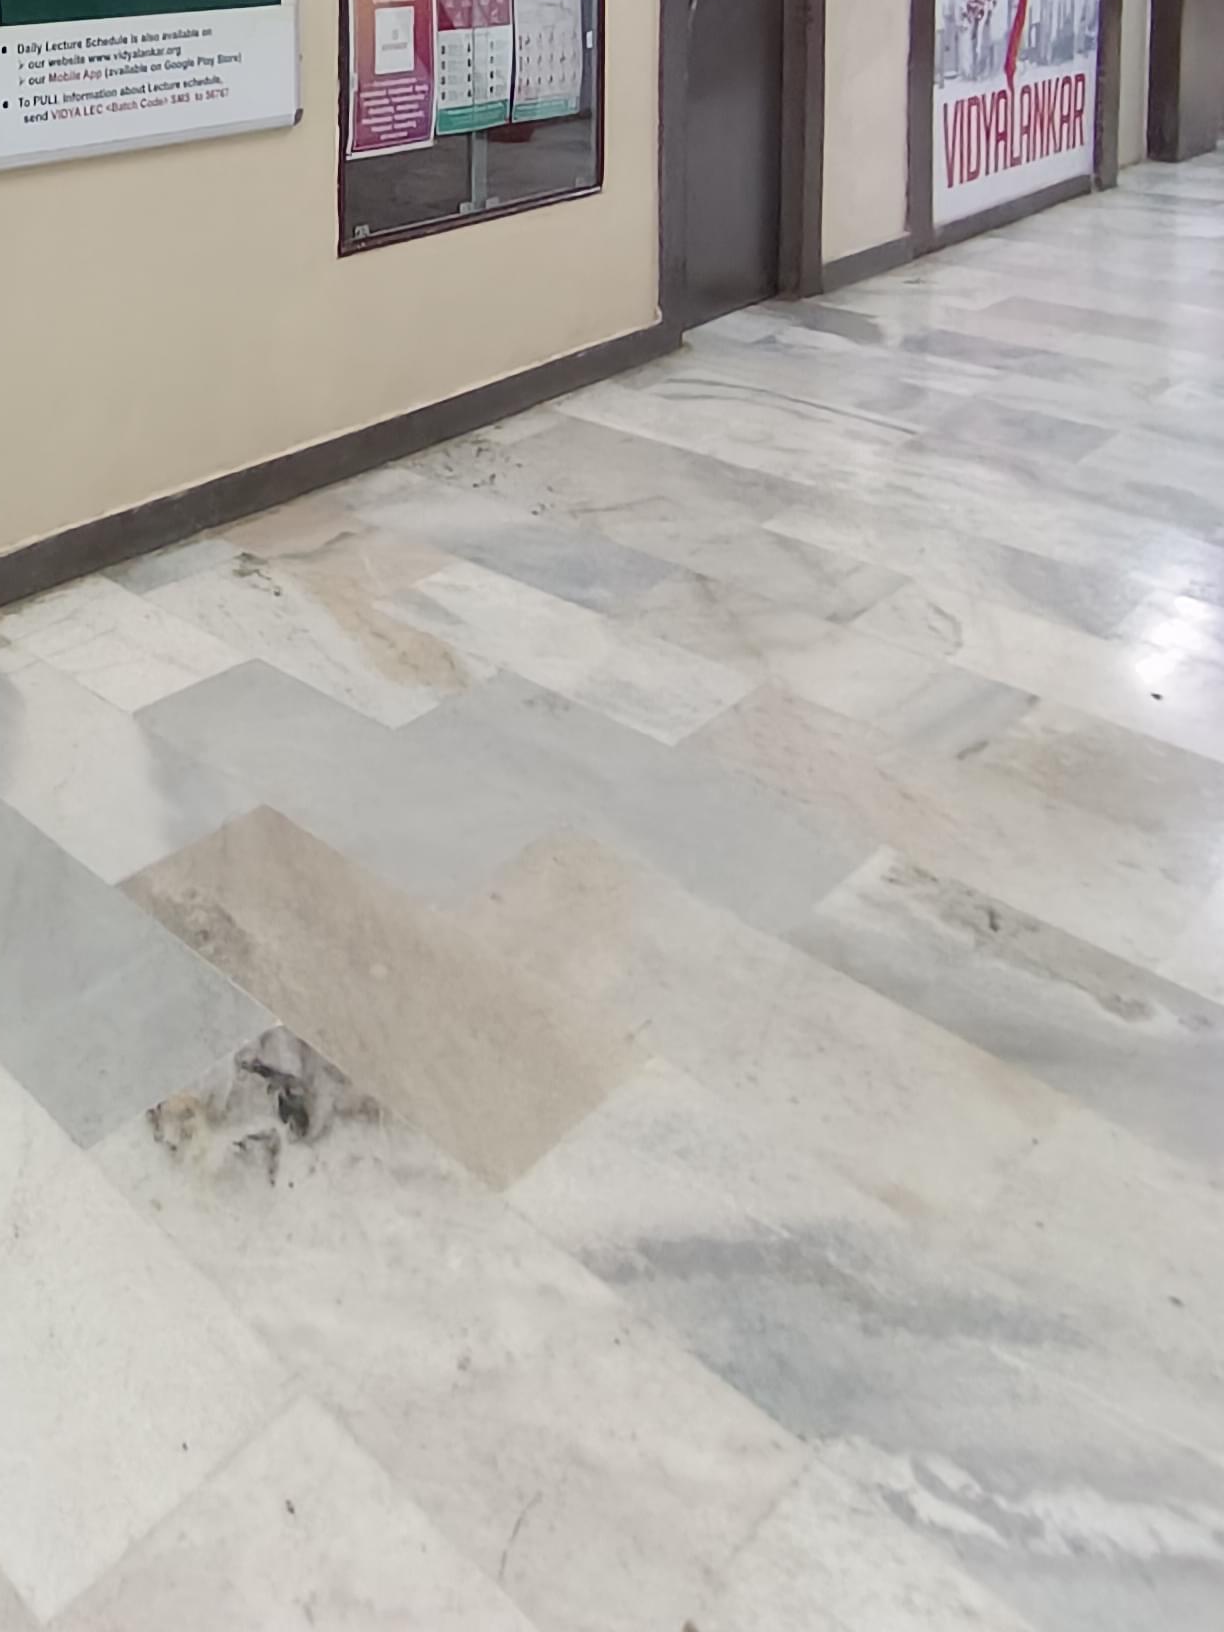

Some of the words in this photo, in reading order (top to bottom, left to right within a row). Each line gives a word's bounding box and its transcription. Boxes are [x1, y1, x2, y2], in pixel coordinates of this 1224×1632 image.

[17, 42, 42, 56] Daily
[45, 39, 82, 53] Lecture
[86, 35, 128, 49] Schedule
[130, 34, 138, 44] is
[141, 32, 160, 44] also
[162, 28, 199, 41] available
[202, 28, 212, 37] on
[28, 60, 45, 70] our
[48, 56, 85, 68] website
[28, 76, 45, 86] our
[48, 71, 80, 83] Mobile
[82, 70, 102, 82] App
[150, 62, 162, 71] on
[164, 58, 194, 70] Google
[197, 56, 214, 67] Play
[18, 97, 30, 108] To
[33, 94, 57, 107] PULL
[120, 85, 145, 96] about
[148, 81, 180, 93] Lecture
[23, 112, 48, 124] send
[51, 107, 81, 121] VIDYA
[83, 104, 103, 116] LEC
[195, 92, 204, 102] to
[942, 73, 1087, 189] VIDYALANKAR
